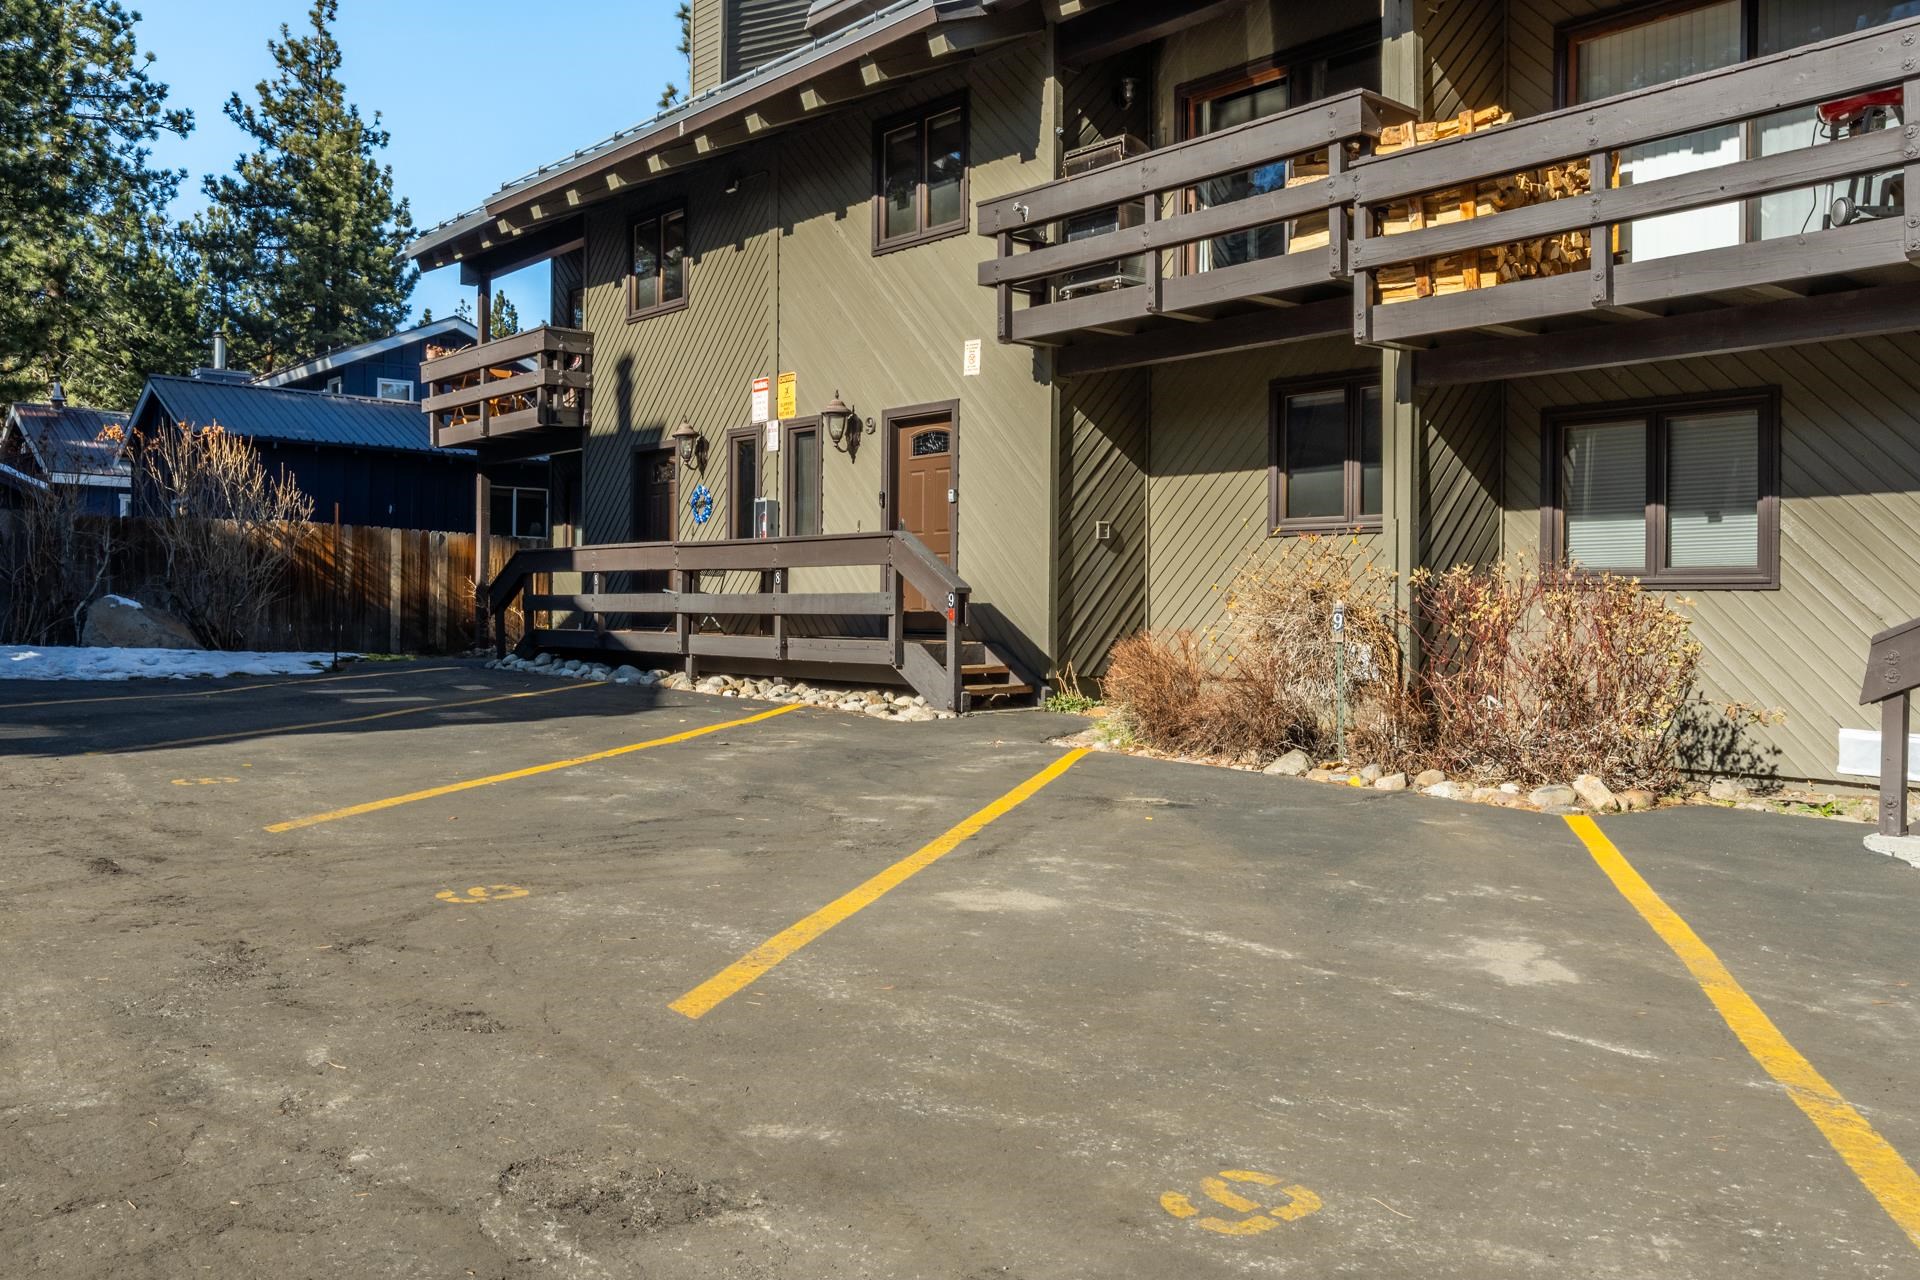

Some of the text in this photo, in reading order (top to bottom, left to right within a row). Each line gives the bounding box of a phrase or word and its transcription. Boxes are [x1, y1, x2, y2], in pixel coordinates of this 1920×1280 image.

[865, 417, 876, 435] 9
[775, 571, 781, 584] 8
[948, 593, 954, 607] 9
[1333, 613, 1343, 629] 9
